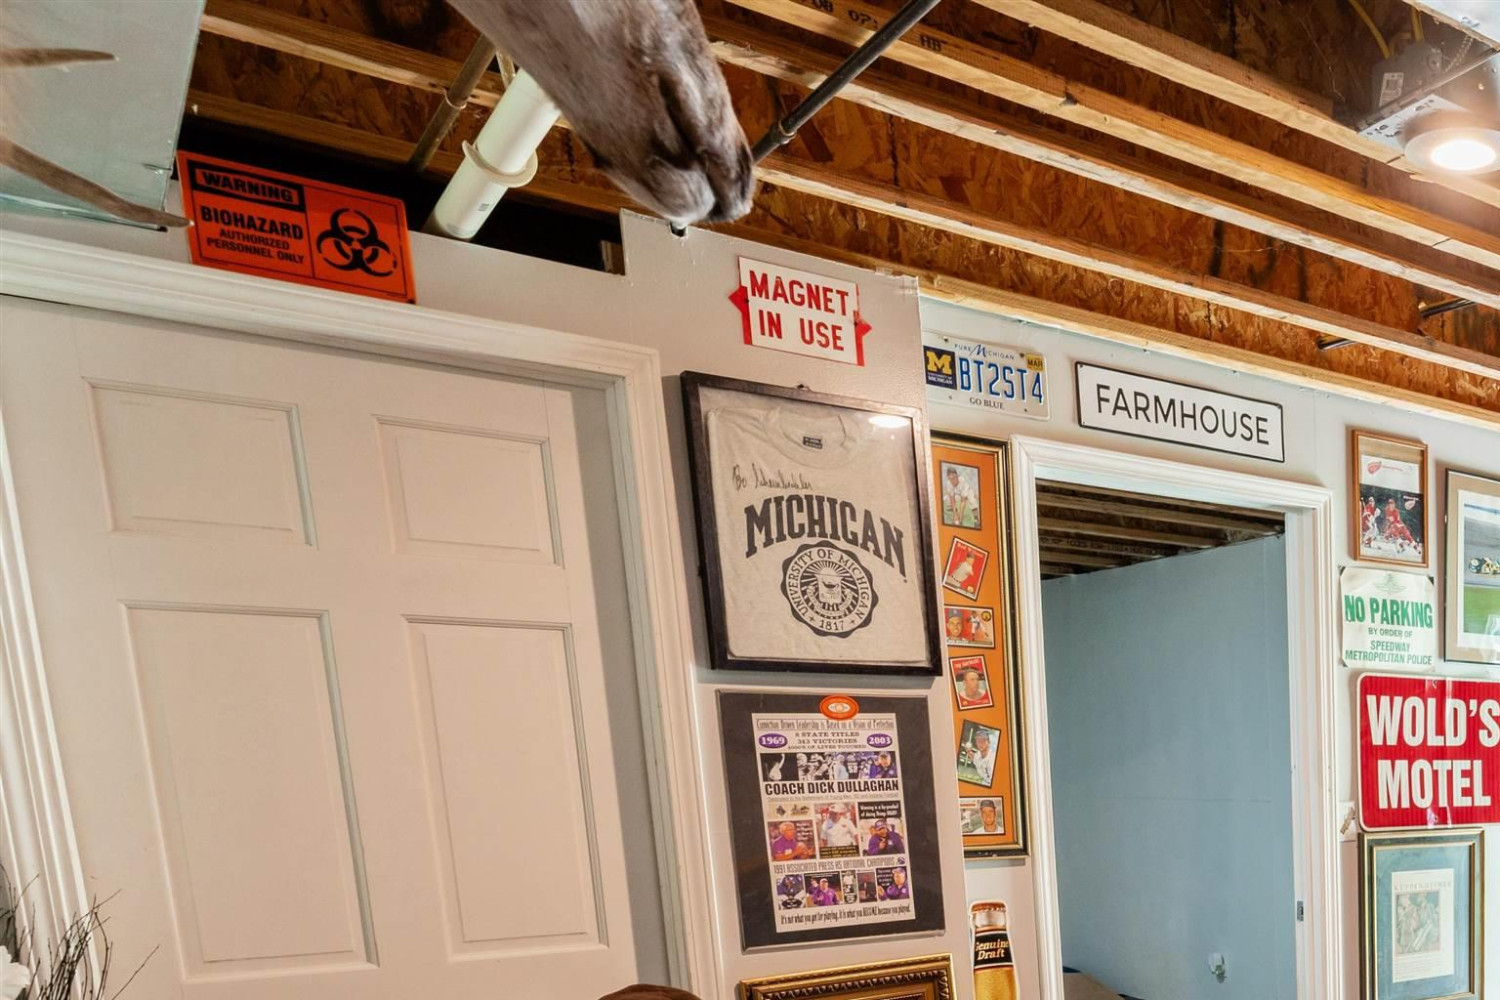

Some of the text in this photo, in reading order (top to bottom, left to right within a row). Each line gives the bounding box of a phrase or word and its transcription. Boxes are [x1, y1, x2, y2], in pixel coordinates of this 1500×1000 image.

[202, 171, 293, 203] WARNING
[200, 205, 303, 240] BIOHAZARD
[207, 238, 305, 265] PERSONNEL ONLY
[219, 229, 290, 250] AUTHORIZED
[750, 270, 849, 316] MAGNET
[758, 309, 844, 351] IN USE
[925, 350, 952, 375] M
[954, 344, 1015, 361] PURE MICHIGAN
[928, 375, 953, 385] MICHIGAN
[958, 357, 1043, 404] BT2ST4
[969, 397, 1004, 409] GO BLUE
[1096, 384, 1269, 445] FARMHOUSE
[744, 494, 906, 578] MICHIGAN
[788, 549, 870, 620] UNIVERSITY OF MICHIGAN
[1344, 595, 1433, 629] NO PARKING
[819, 621, 844, 631] 1817
[1368, 627, 1378, 635] BY
[1380, 628, 1402, 637] ORDER
[1344, 650, 1433, 665] METROPOLITAN POLICE
[1370, 640, 1410, 652] SPEEDWAY
[1366, 695, 1500, 748] WOLD'S
[761, 736, 785, 745] 1969
[765, 780, 899, 795] COACH DICK DULLAGHAN
[1377, 759, 1491, 809] MOTEL
[774, 863, 786, 873] 1991
[818, 860, 834, 871] PRESS
[977, 948, 1005, 960] Draft
